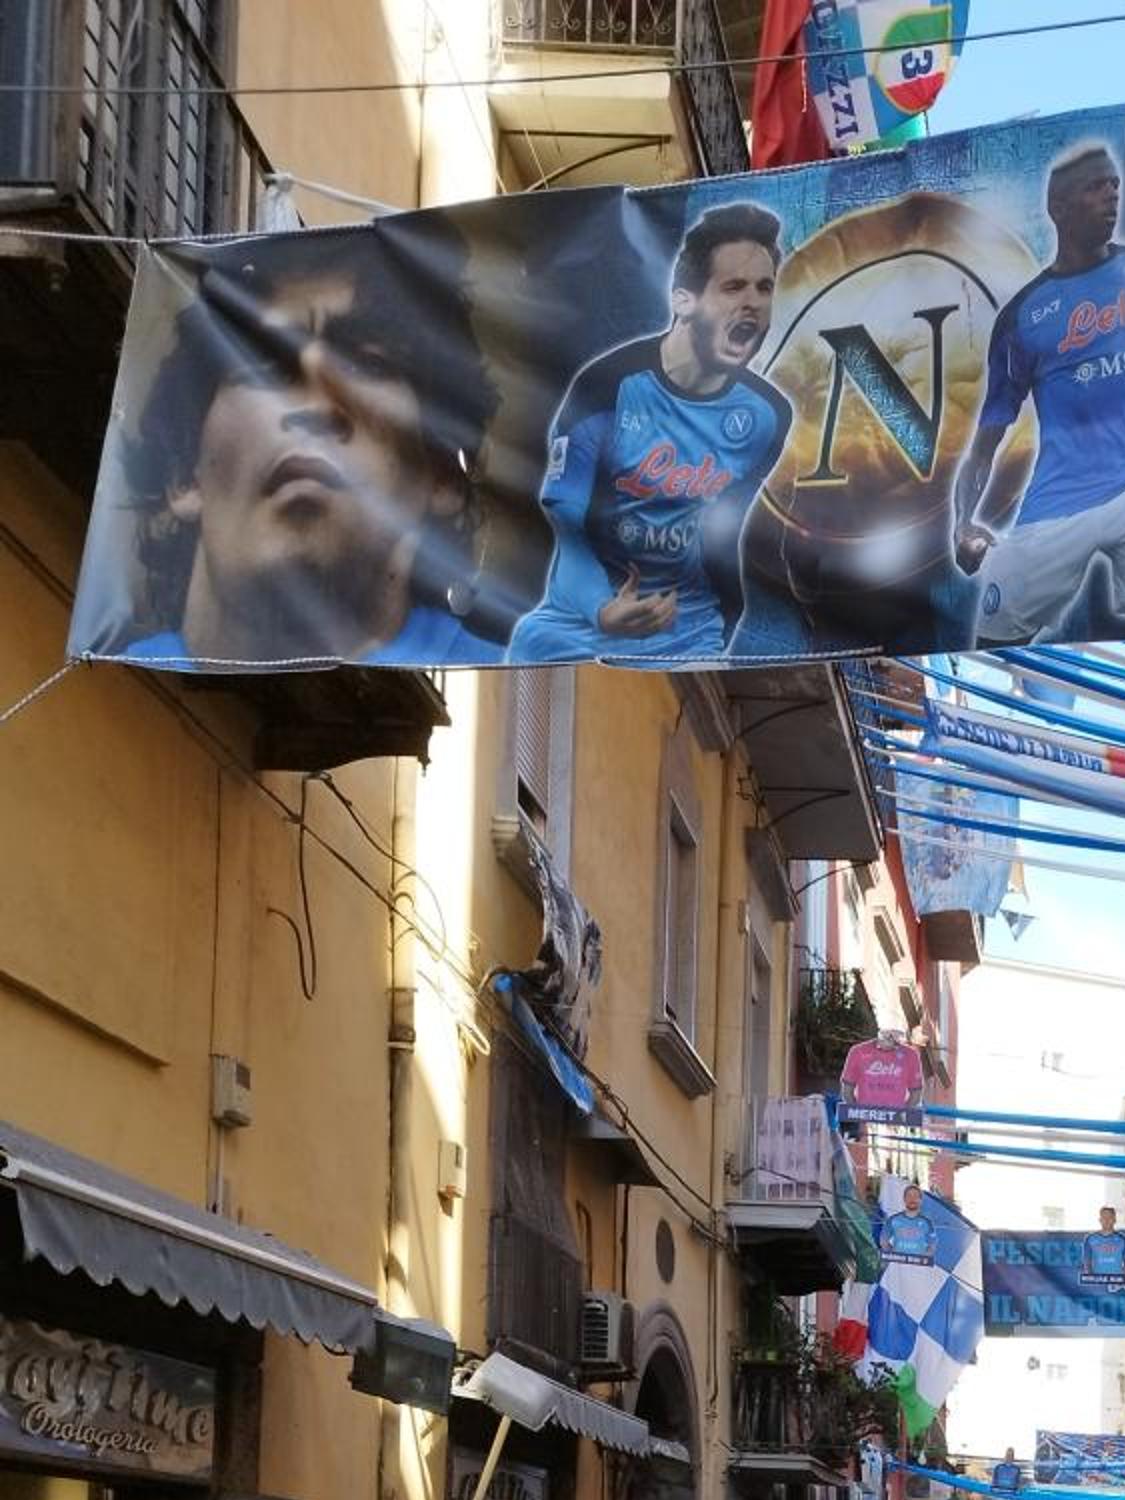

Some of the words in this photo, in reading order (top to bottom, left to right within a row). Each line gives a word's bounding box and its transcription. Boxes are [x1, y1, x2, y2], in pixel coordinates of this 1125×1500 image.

[902, 49, 933, 79] 3
[793, 303, 960, 486] N
[644, 520, 696, 552] MSC
[847, 1108, 896, 1121] MERET
[21, 1400, 160, 1458] Orologeria
